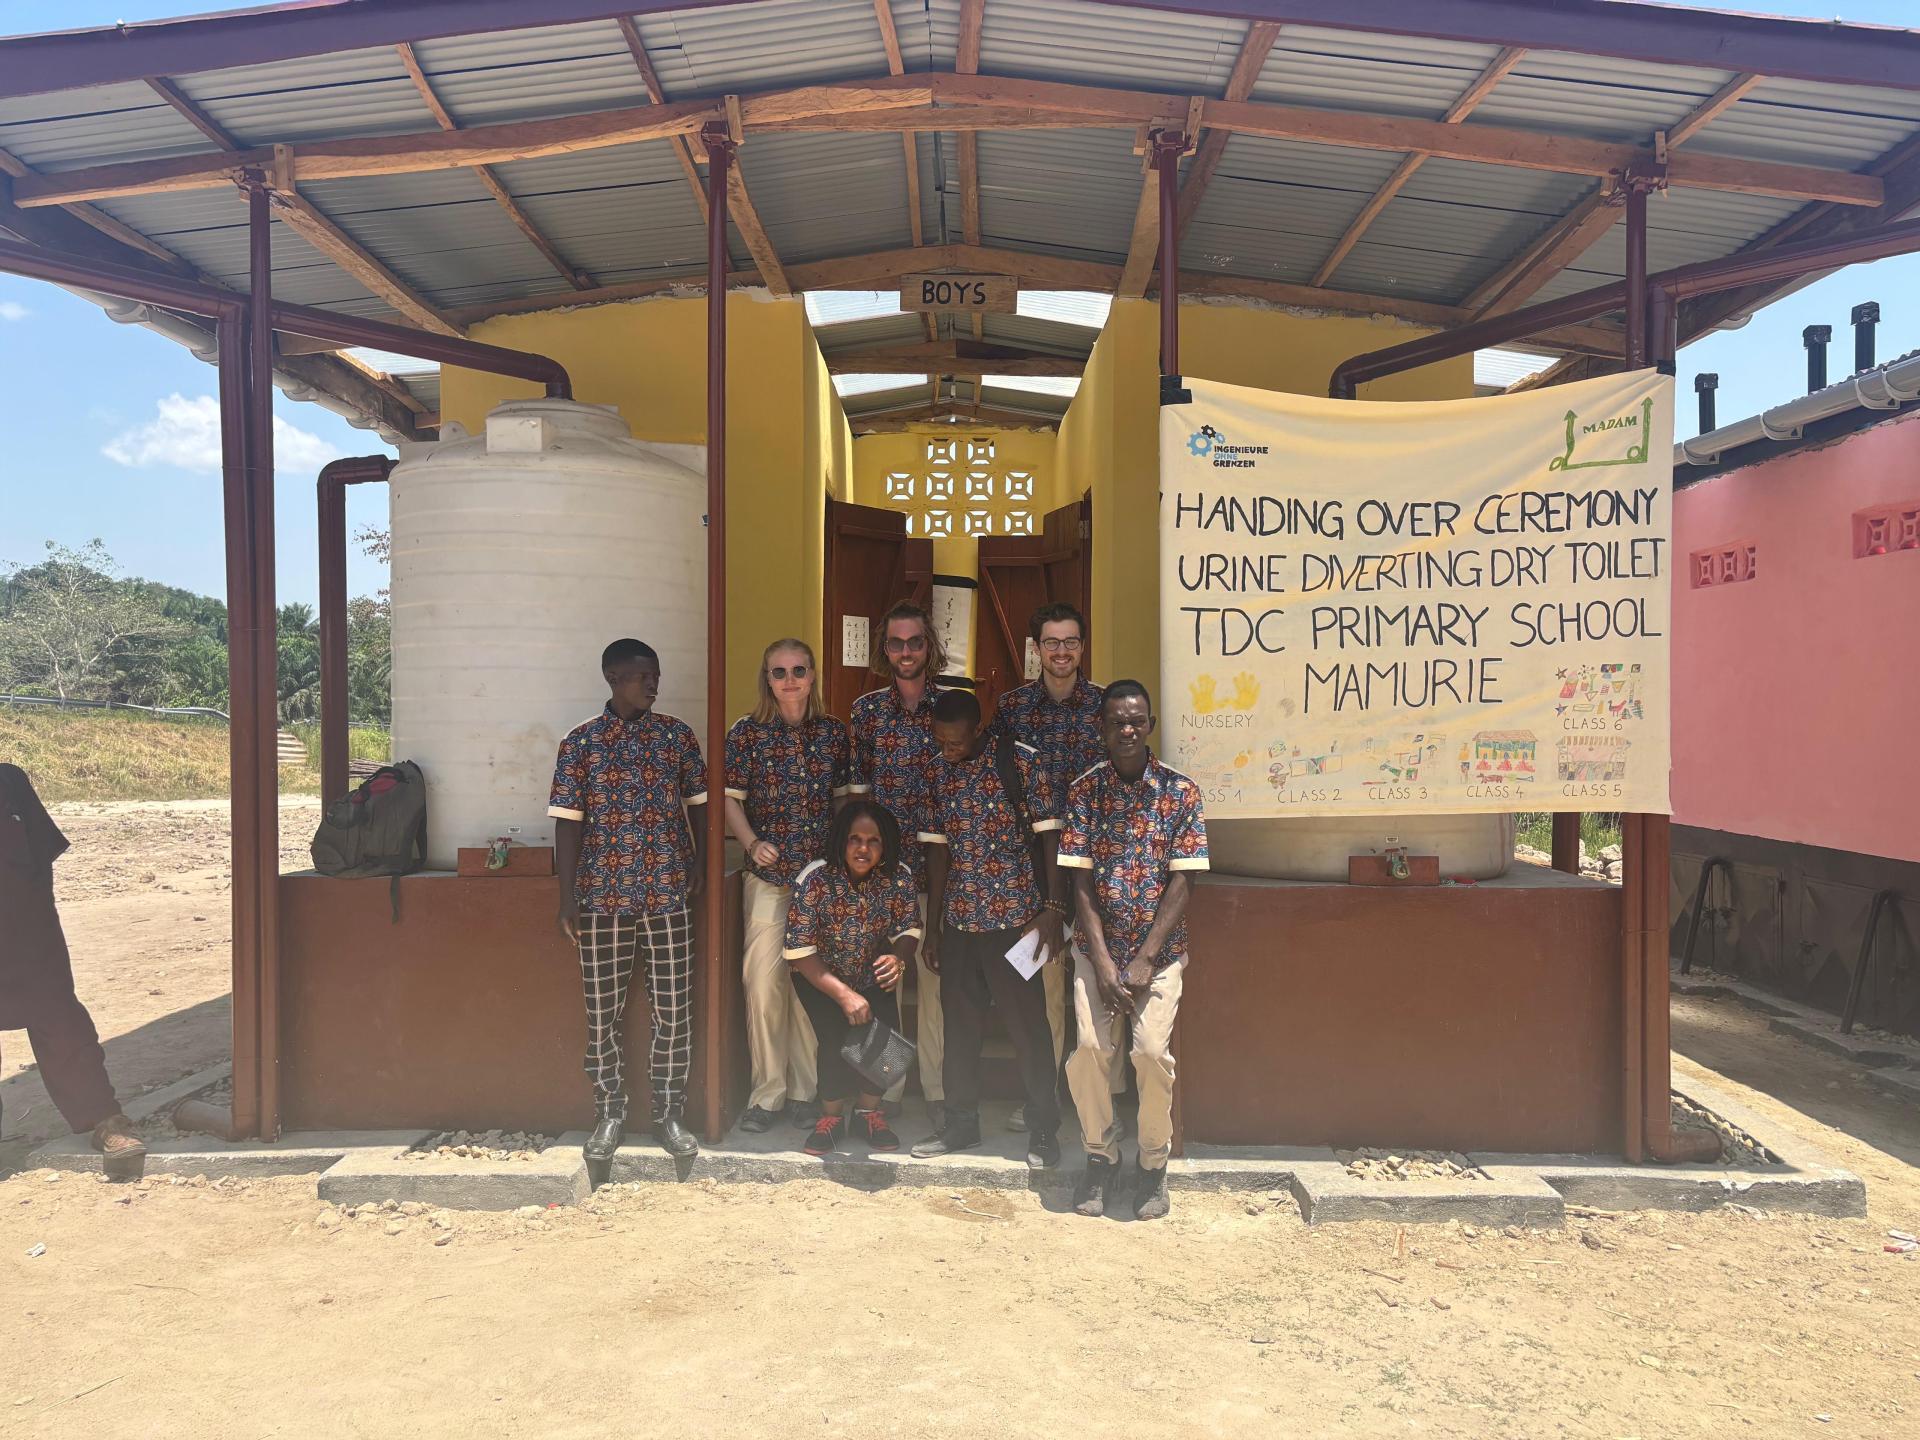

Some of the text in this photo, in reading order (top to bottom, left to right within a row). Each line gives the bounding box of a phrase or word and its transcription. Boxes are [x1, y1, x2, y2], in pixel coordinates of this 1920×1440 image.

[922, 280, 986, 305] BOYS
[1582, 415, 1638, 434] MADAM
[1214, 445, 1269, 454] INGENIEURE
[1213, 460, 1256, 468] GRENZEN
[1175, 487, 1659, 540] HANDING OVER CEREMONY
[1178, 537, 1666, 592] URINE DIVERTING DRY TOILET
[1180, 597, 1662, 656] TDC PRIMARY SCHOOL
[1303, 657, 1503, 714] MAMURIE
[1181, 713, 1254, 729] NURSERY
[1562, 718, 1623, 731] CLASS 6
[1200, 788, 1242, 803] ASS 1
[1277, 788, 1343, 804] CLASS 2
[1368, 786, 1428, 800] CLASS 3
[1466, 785, 1524, 799] CLASS 4
[1562, 783, 1623, 797] CLASS 5
